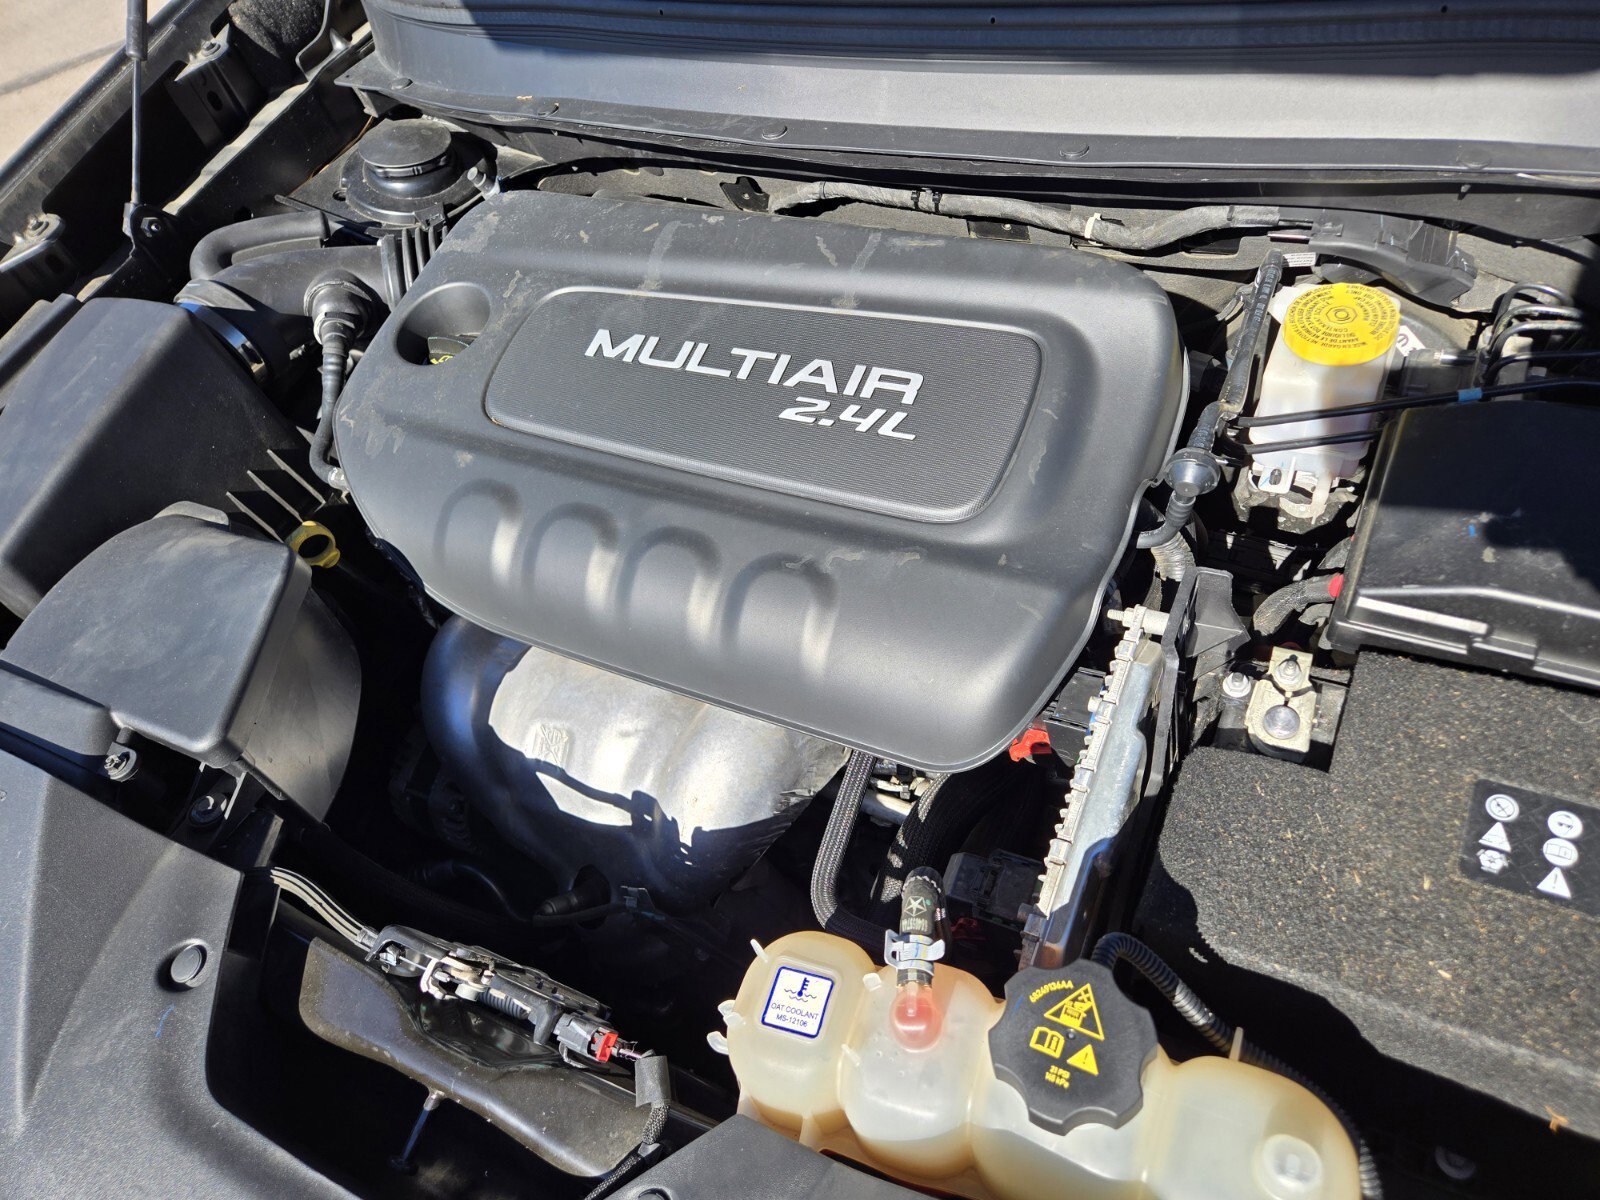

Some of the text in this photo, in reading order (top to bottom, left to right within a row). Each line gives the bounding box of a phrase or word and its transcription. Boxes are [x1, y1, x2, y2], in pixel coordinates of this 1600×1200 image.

[584, 328, 924, 406] MULTIAIR
[778, 396, 916, 440] 2.4L
[771, 1002, 819, 1020] OAT COOLANT
[776, 1013, 808, 1027] MS-12106
